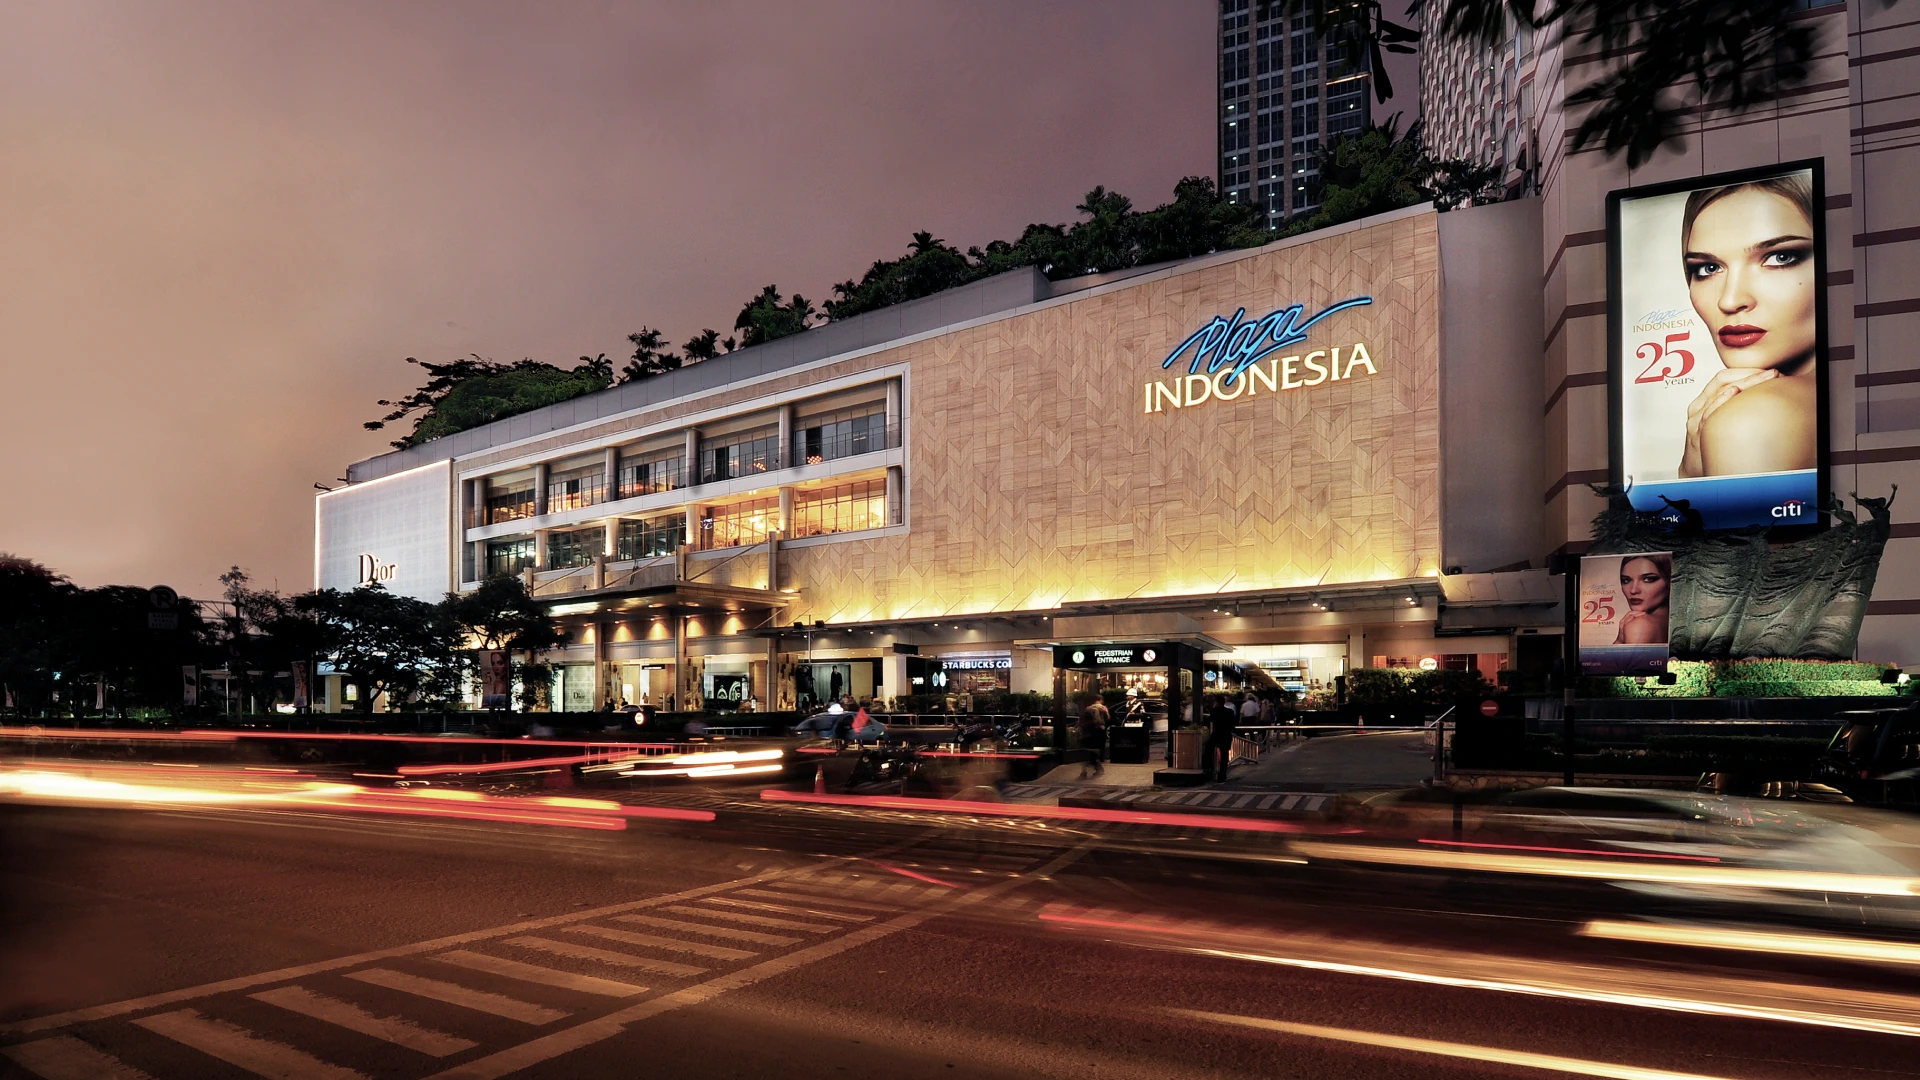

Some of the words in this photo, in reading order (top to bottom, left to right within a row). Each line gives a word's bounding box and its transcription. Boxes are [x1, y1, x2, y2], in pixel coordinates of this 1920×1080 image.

[1633, 318, 1694, 333] INDONESIA
[1638, 308, 1692, 325] Plaza
[1162, 296, 1373, 386] Plaza
[1635, 330, 1695, 384] 25
[1144, 342, 1377, 414] INDONESIA
[1664, 376, 1695, 389] years
[1770, 499, 1804, 519] citi
[358, 553, 396, 584] Dior
[1582, 596, 1615, 623] 25
[942, 661, 995, 670] STARBUCKS
[573, 692, 585, 700] Dior
